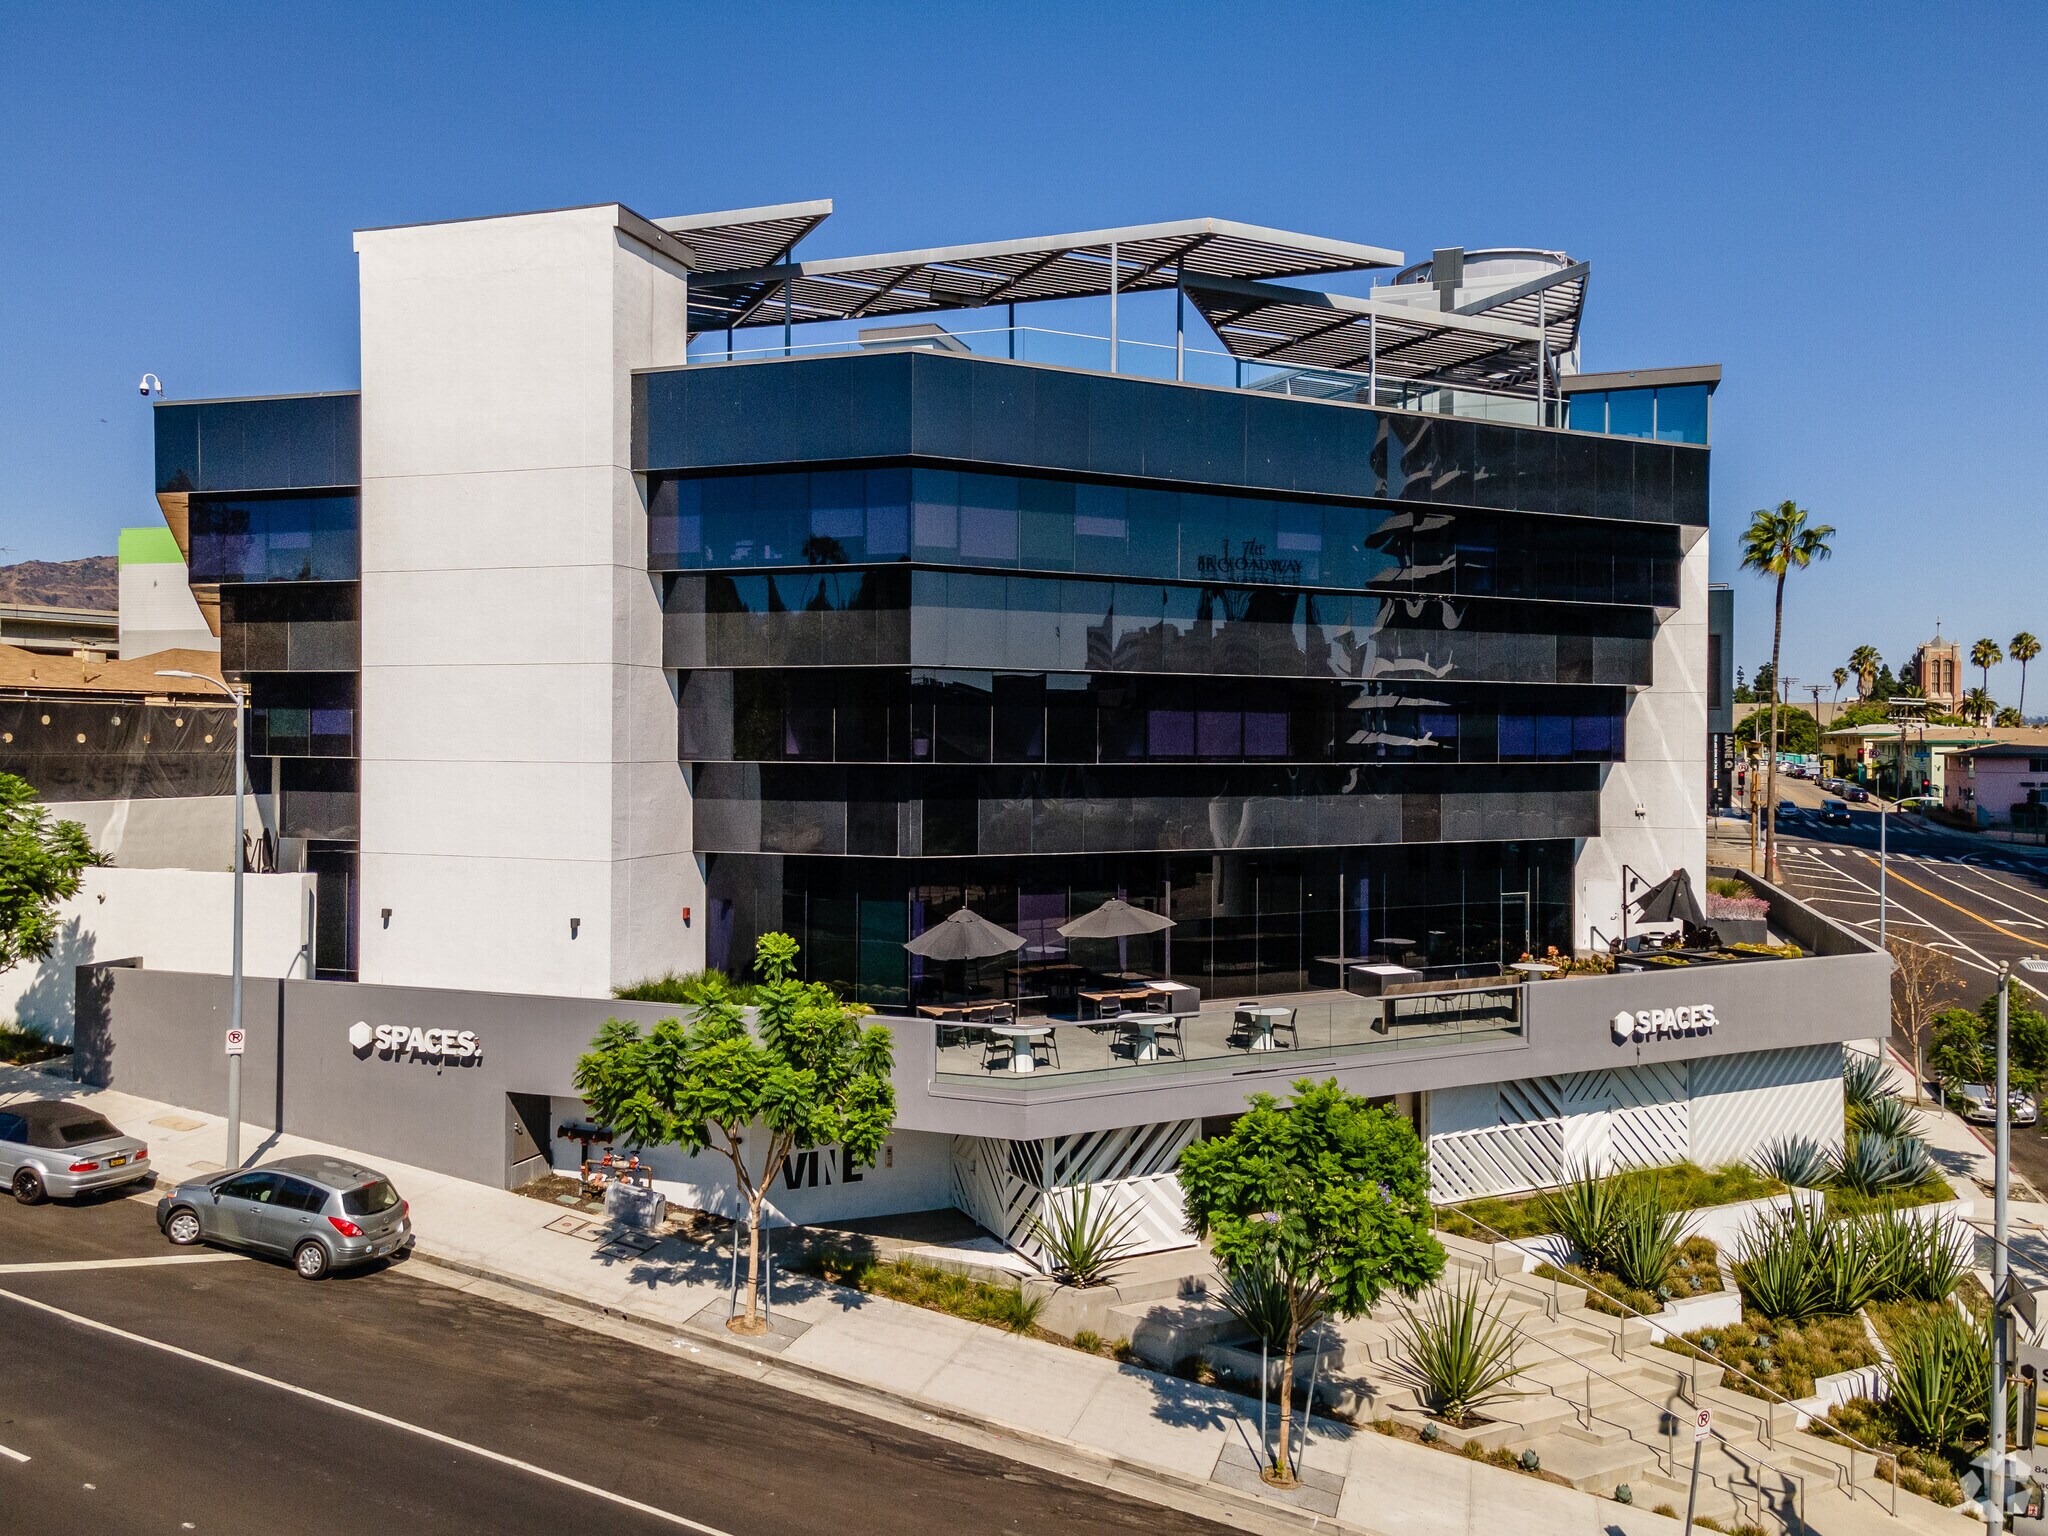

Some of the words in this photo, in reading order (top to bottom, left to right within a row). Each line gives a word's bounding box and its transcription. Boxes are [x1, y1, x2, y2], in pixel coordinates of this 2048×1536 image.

[1724, 735, 1733, 759] JANE
[1724, 760, 1734, 769] Q
[780, 1147, 864, 1190] VINE
